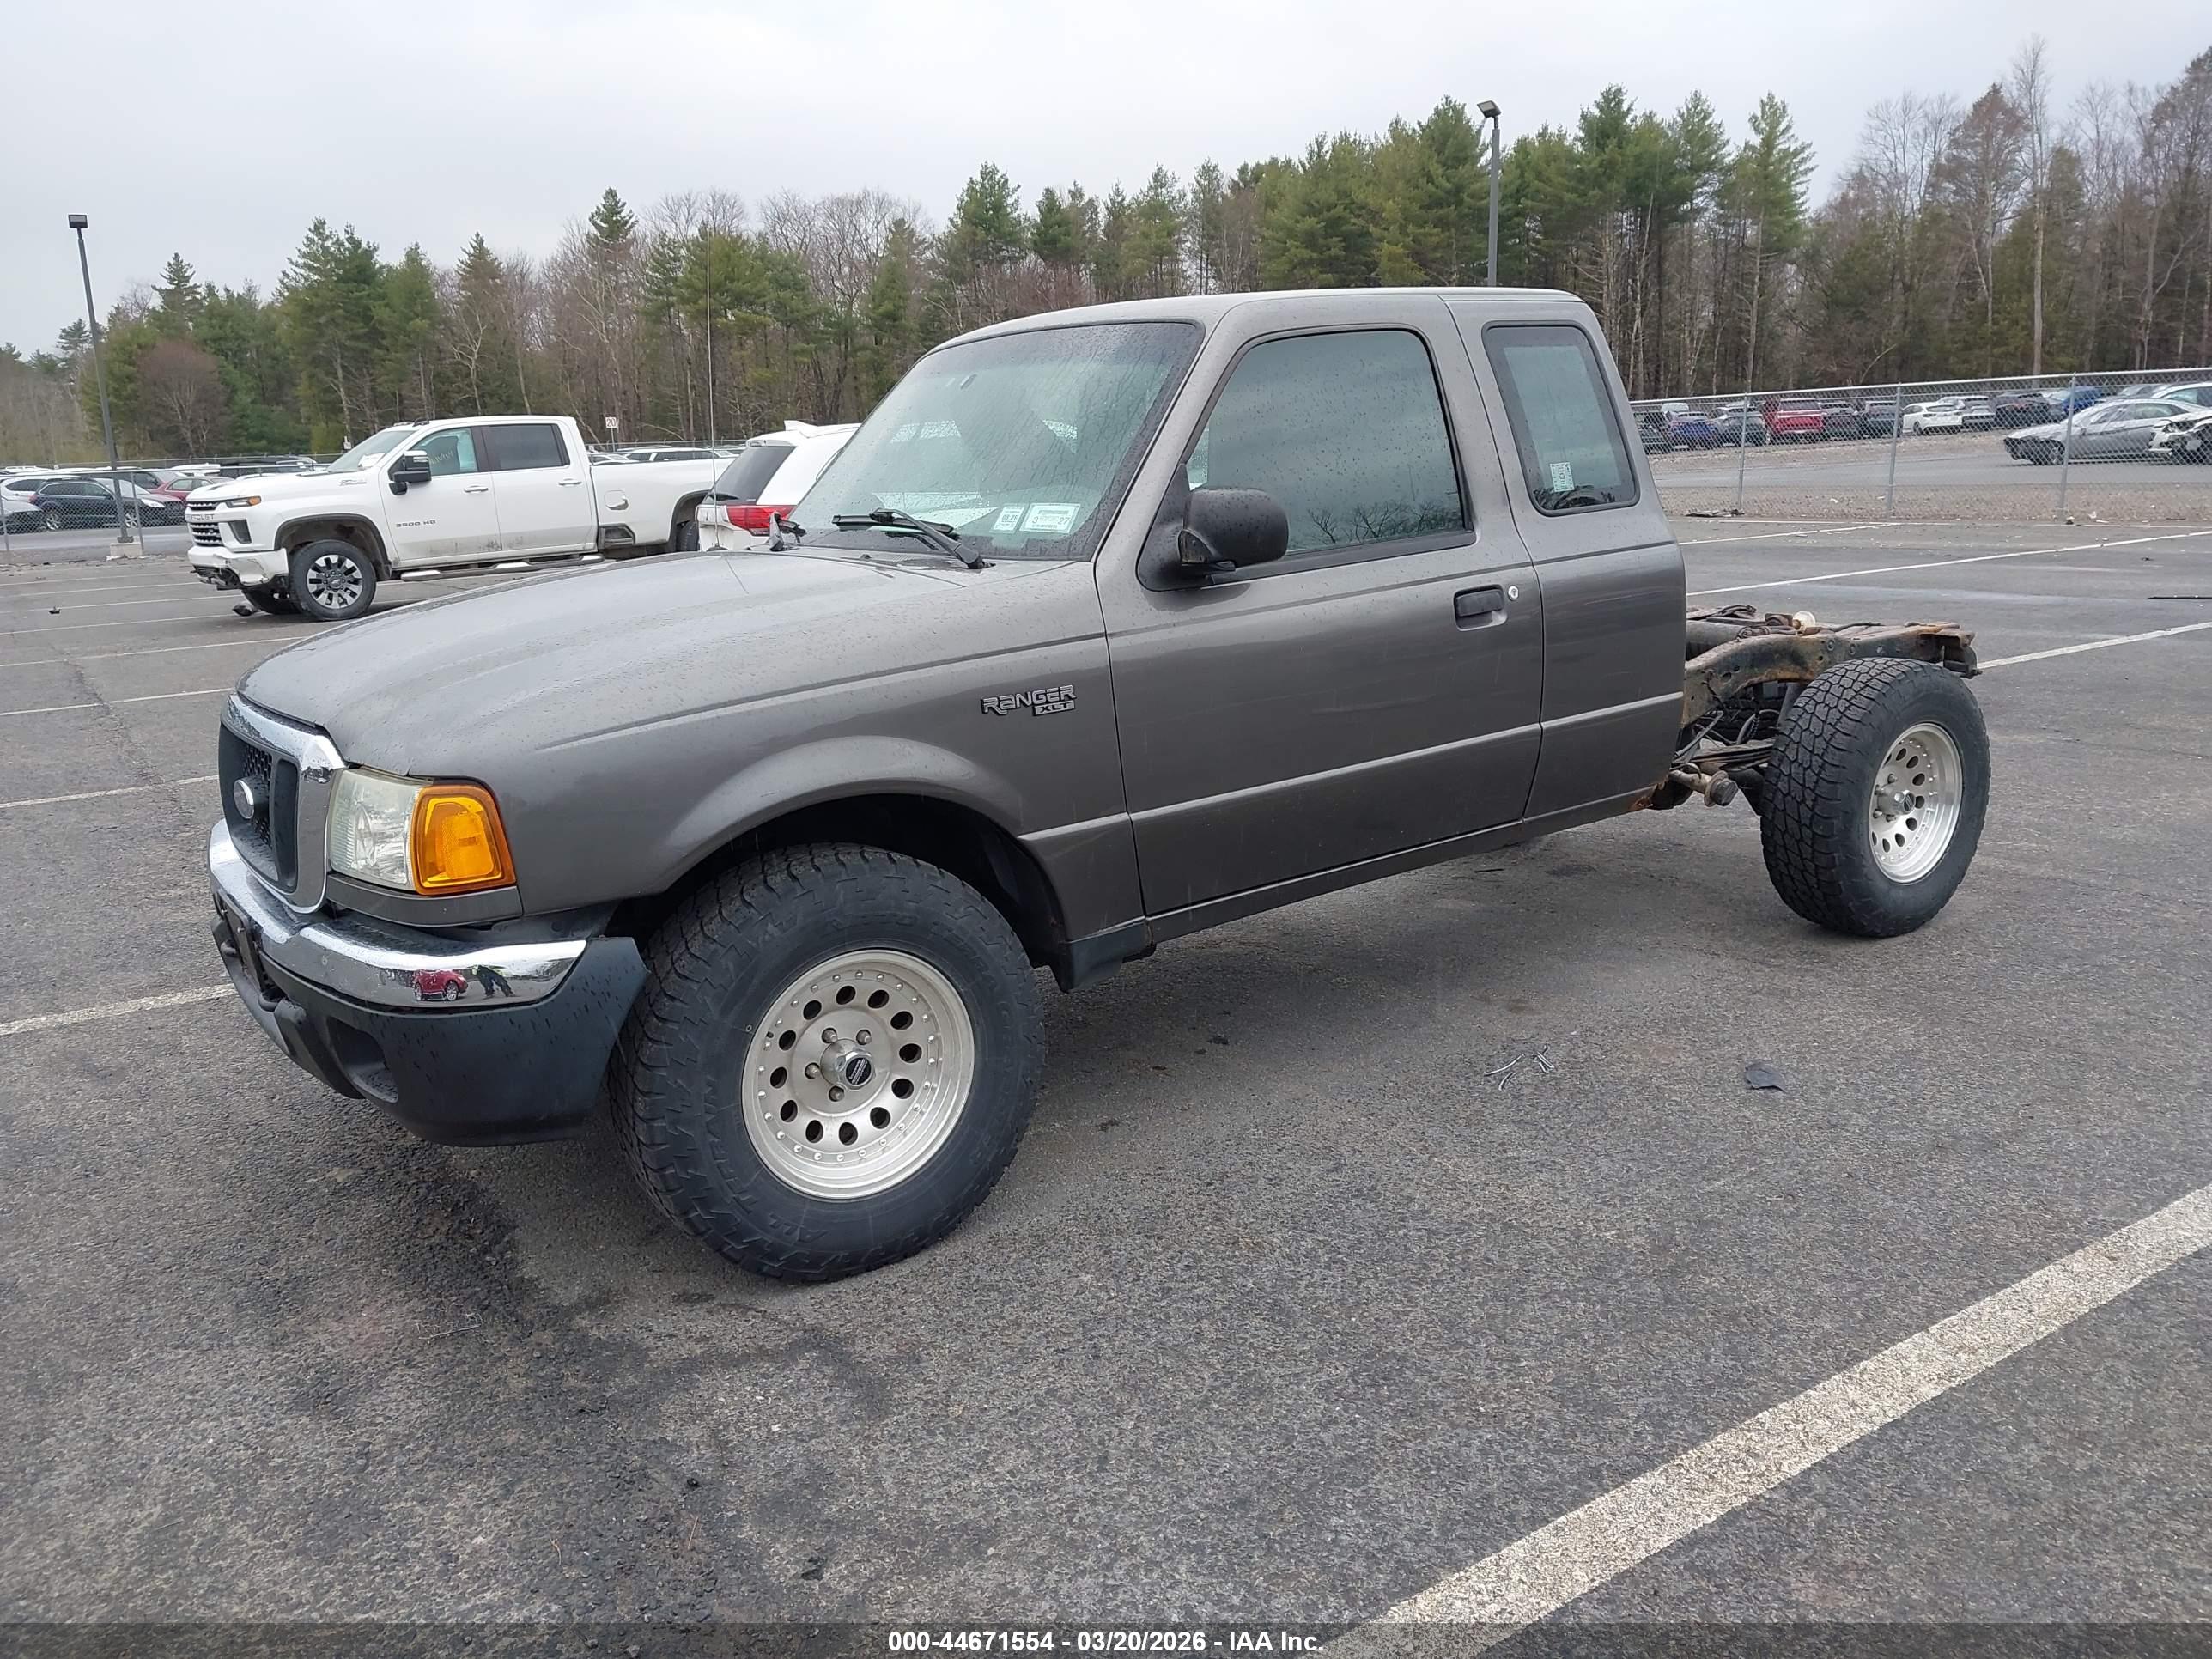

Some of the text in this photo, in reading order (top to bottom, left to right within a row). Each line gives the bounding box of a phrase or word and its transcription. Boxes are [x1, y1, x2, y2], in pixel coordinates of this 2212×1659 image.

[606, 417, 617, 427] 20
[1031, 515, 1039, 524] 3
[1057, 517, 1071, 526] 27
[981, 684, 1077, 715] RANGER
[1039, 702, 1069, 713] XLT
